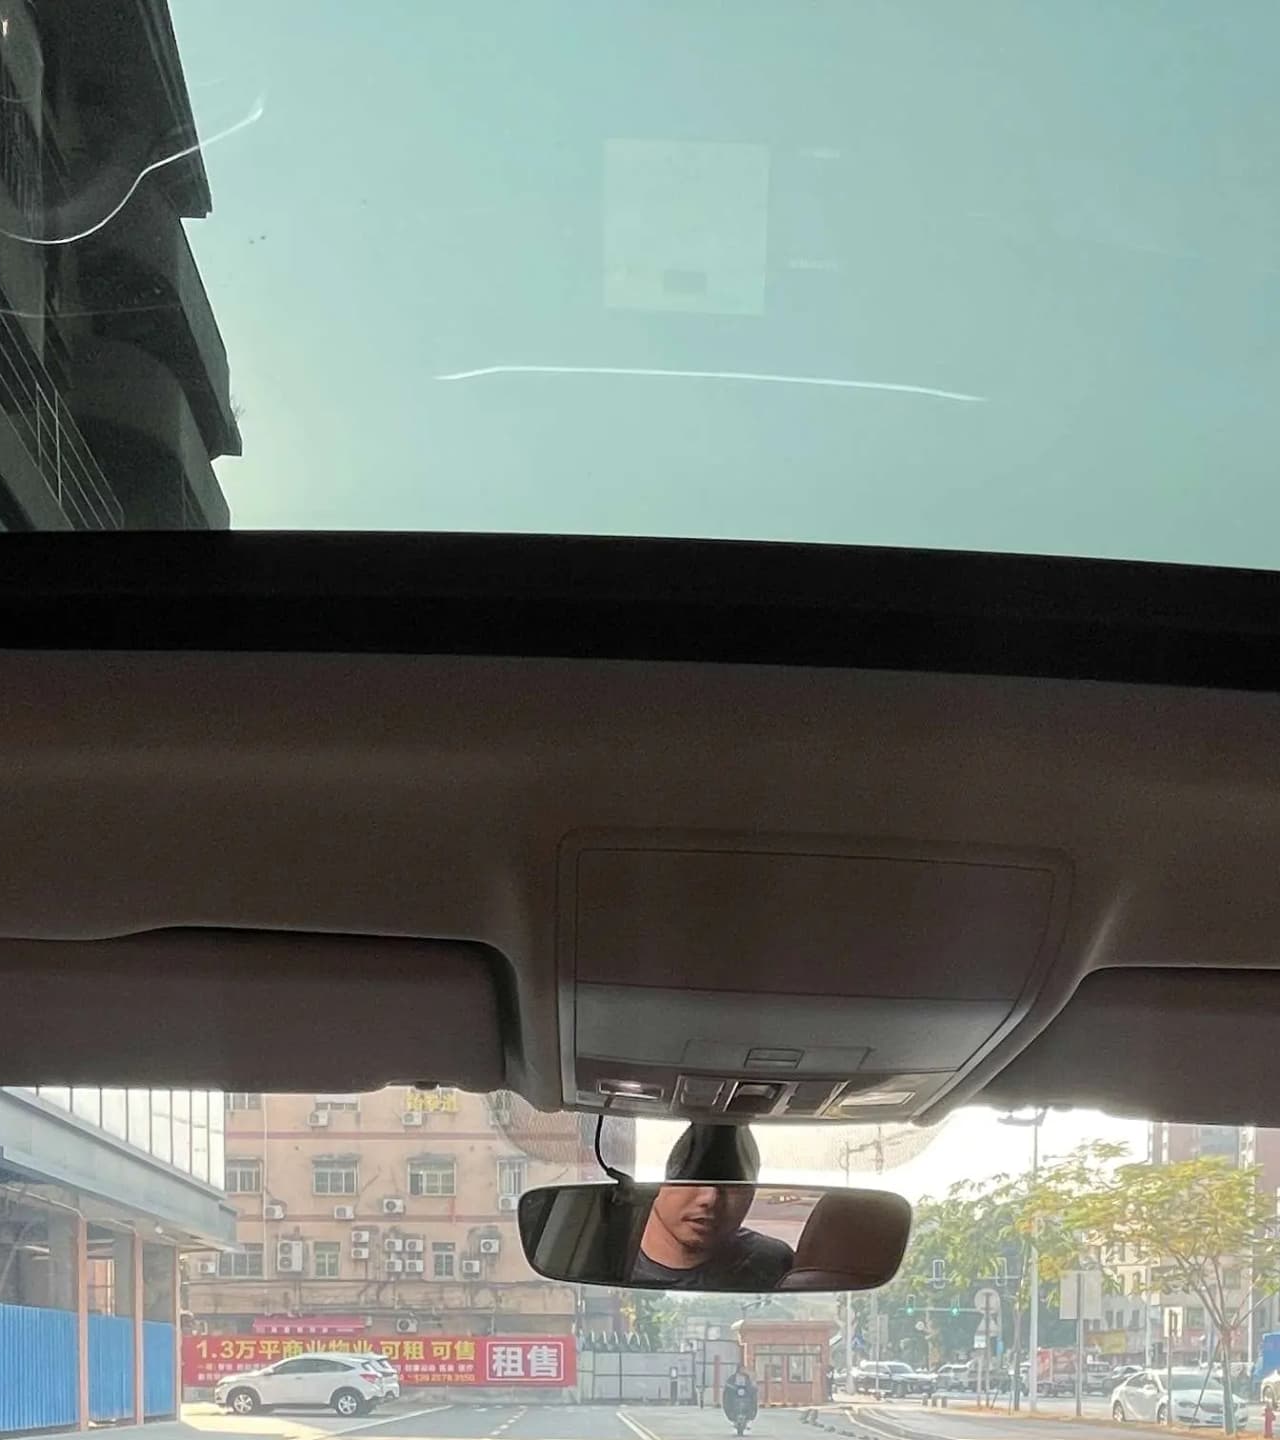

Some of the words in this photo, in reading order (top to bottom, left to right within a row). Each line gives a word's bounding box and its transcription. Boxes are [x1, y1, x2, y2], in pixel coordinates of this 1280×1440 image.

[380, 1340, 424, 1360] 可租
[431, 1340, 475, 1360] 可售
[492, 1345, 559, 1378] 租售
